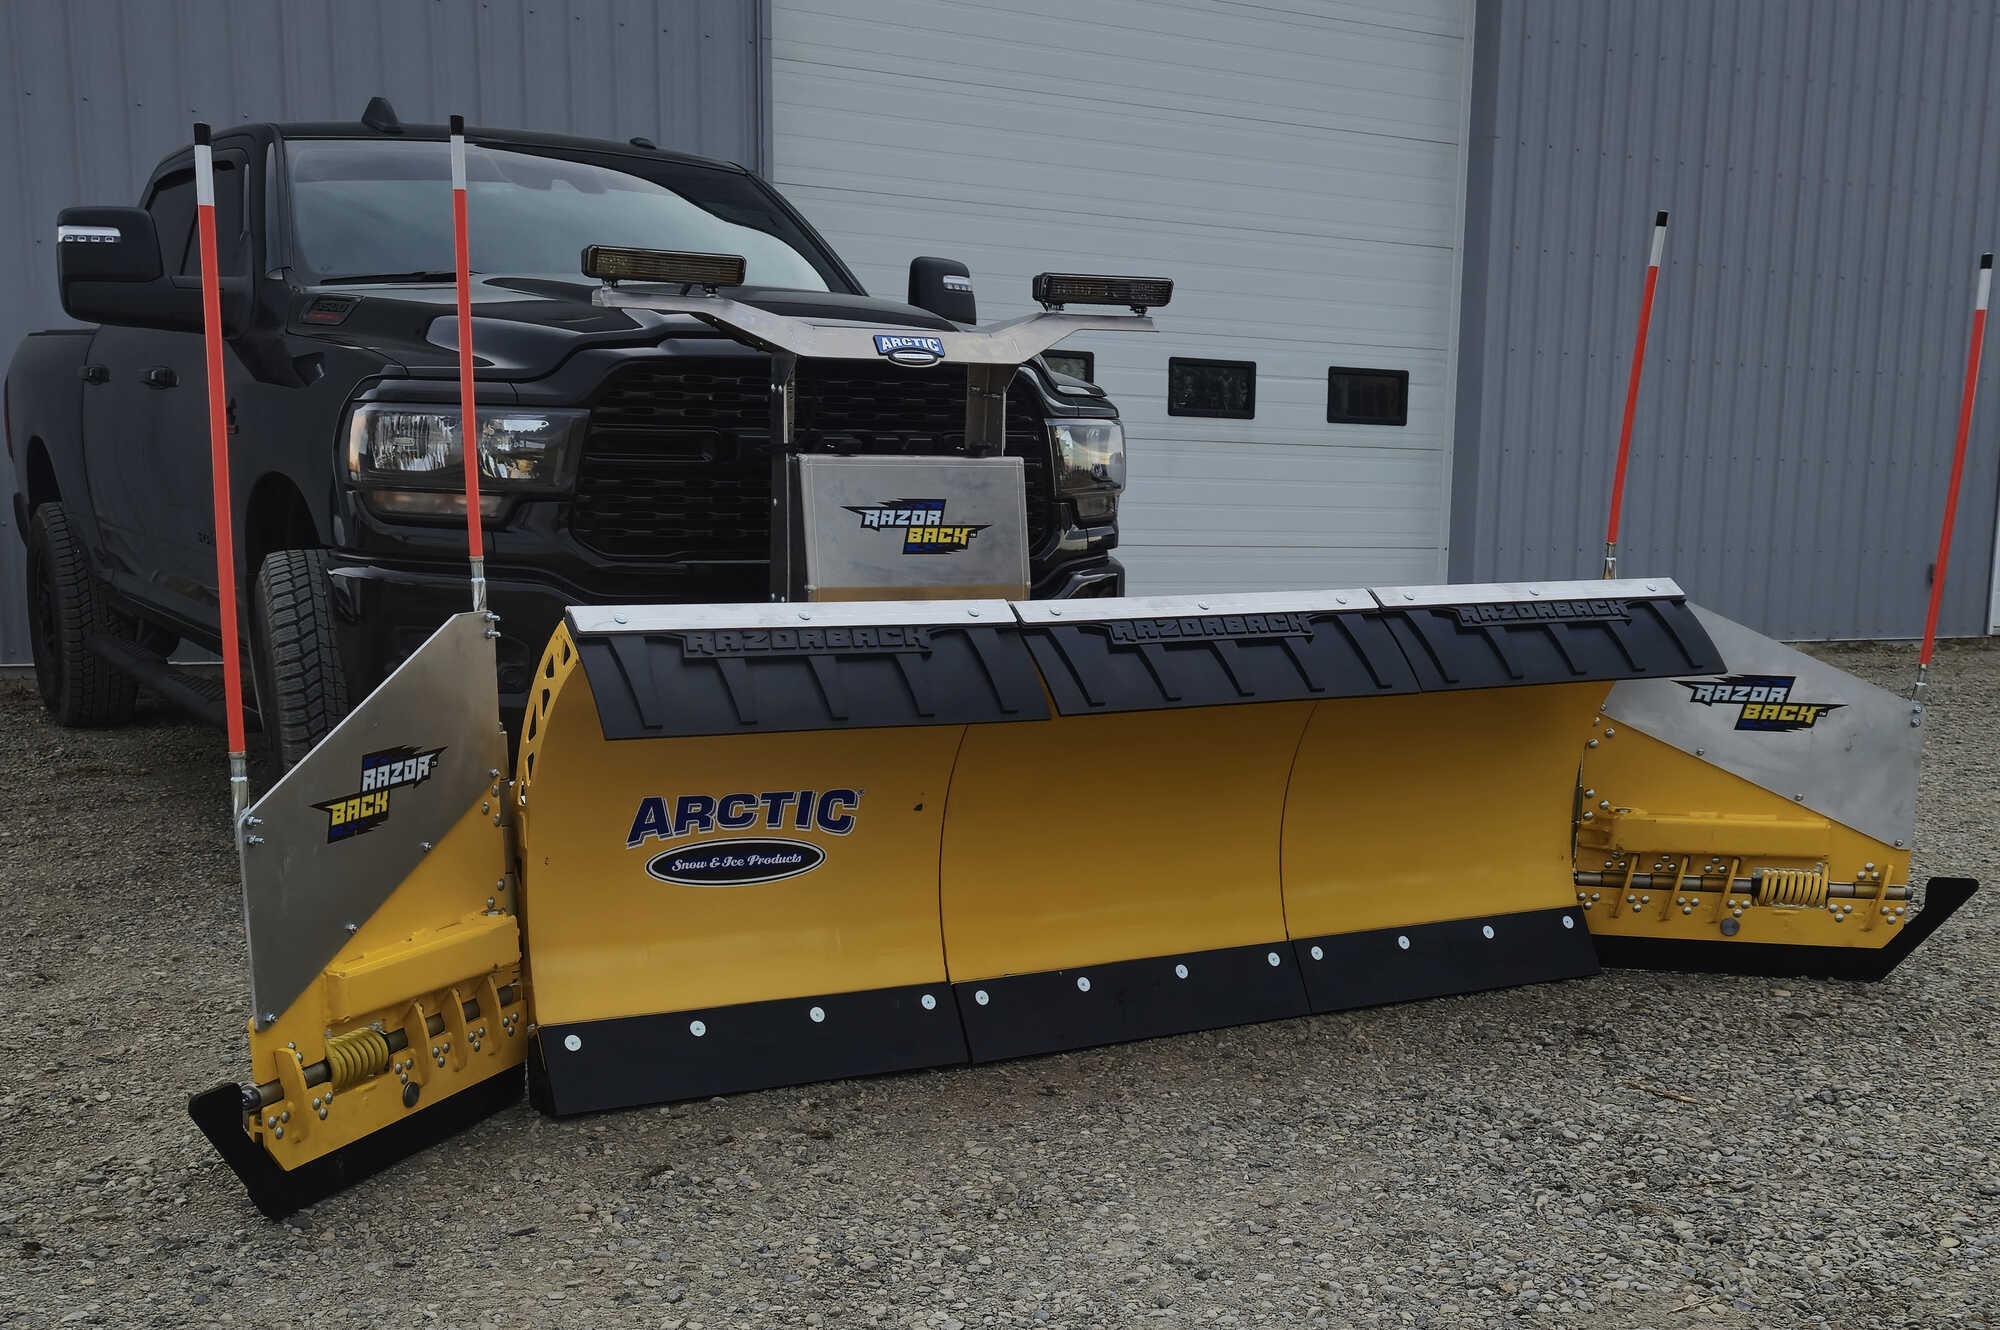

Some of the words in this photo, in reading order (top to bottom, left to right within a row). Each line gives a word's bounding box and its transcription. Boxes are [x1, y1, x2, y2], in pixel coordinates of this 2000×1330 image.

[881, 337, 940, 352] ARCTIC
[861, 509, 942, 528] RAZOR
[907, 527, 972, 545] BACK
[1458, 599, 1630, 624] RAZORBACK
[1110, 613, 1313, 642] RAZORBACK
[686, 627, 932, 655] RAZORBACK
[1693, 684, 1789, 703] RAZOR
[1742, 703, 1825, 724] BACK
[362, 753, 436, 792] RAZOR
[326, 790, 389, 826] BACK
[626, 789, 860, 849] ARCTIC
[671, 859, 707, 872] Snow
[709, 857, 721, 868] &
[722, 856, 744, 868] Ice
[747, 853, 802, 867] Products
